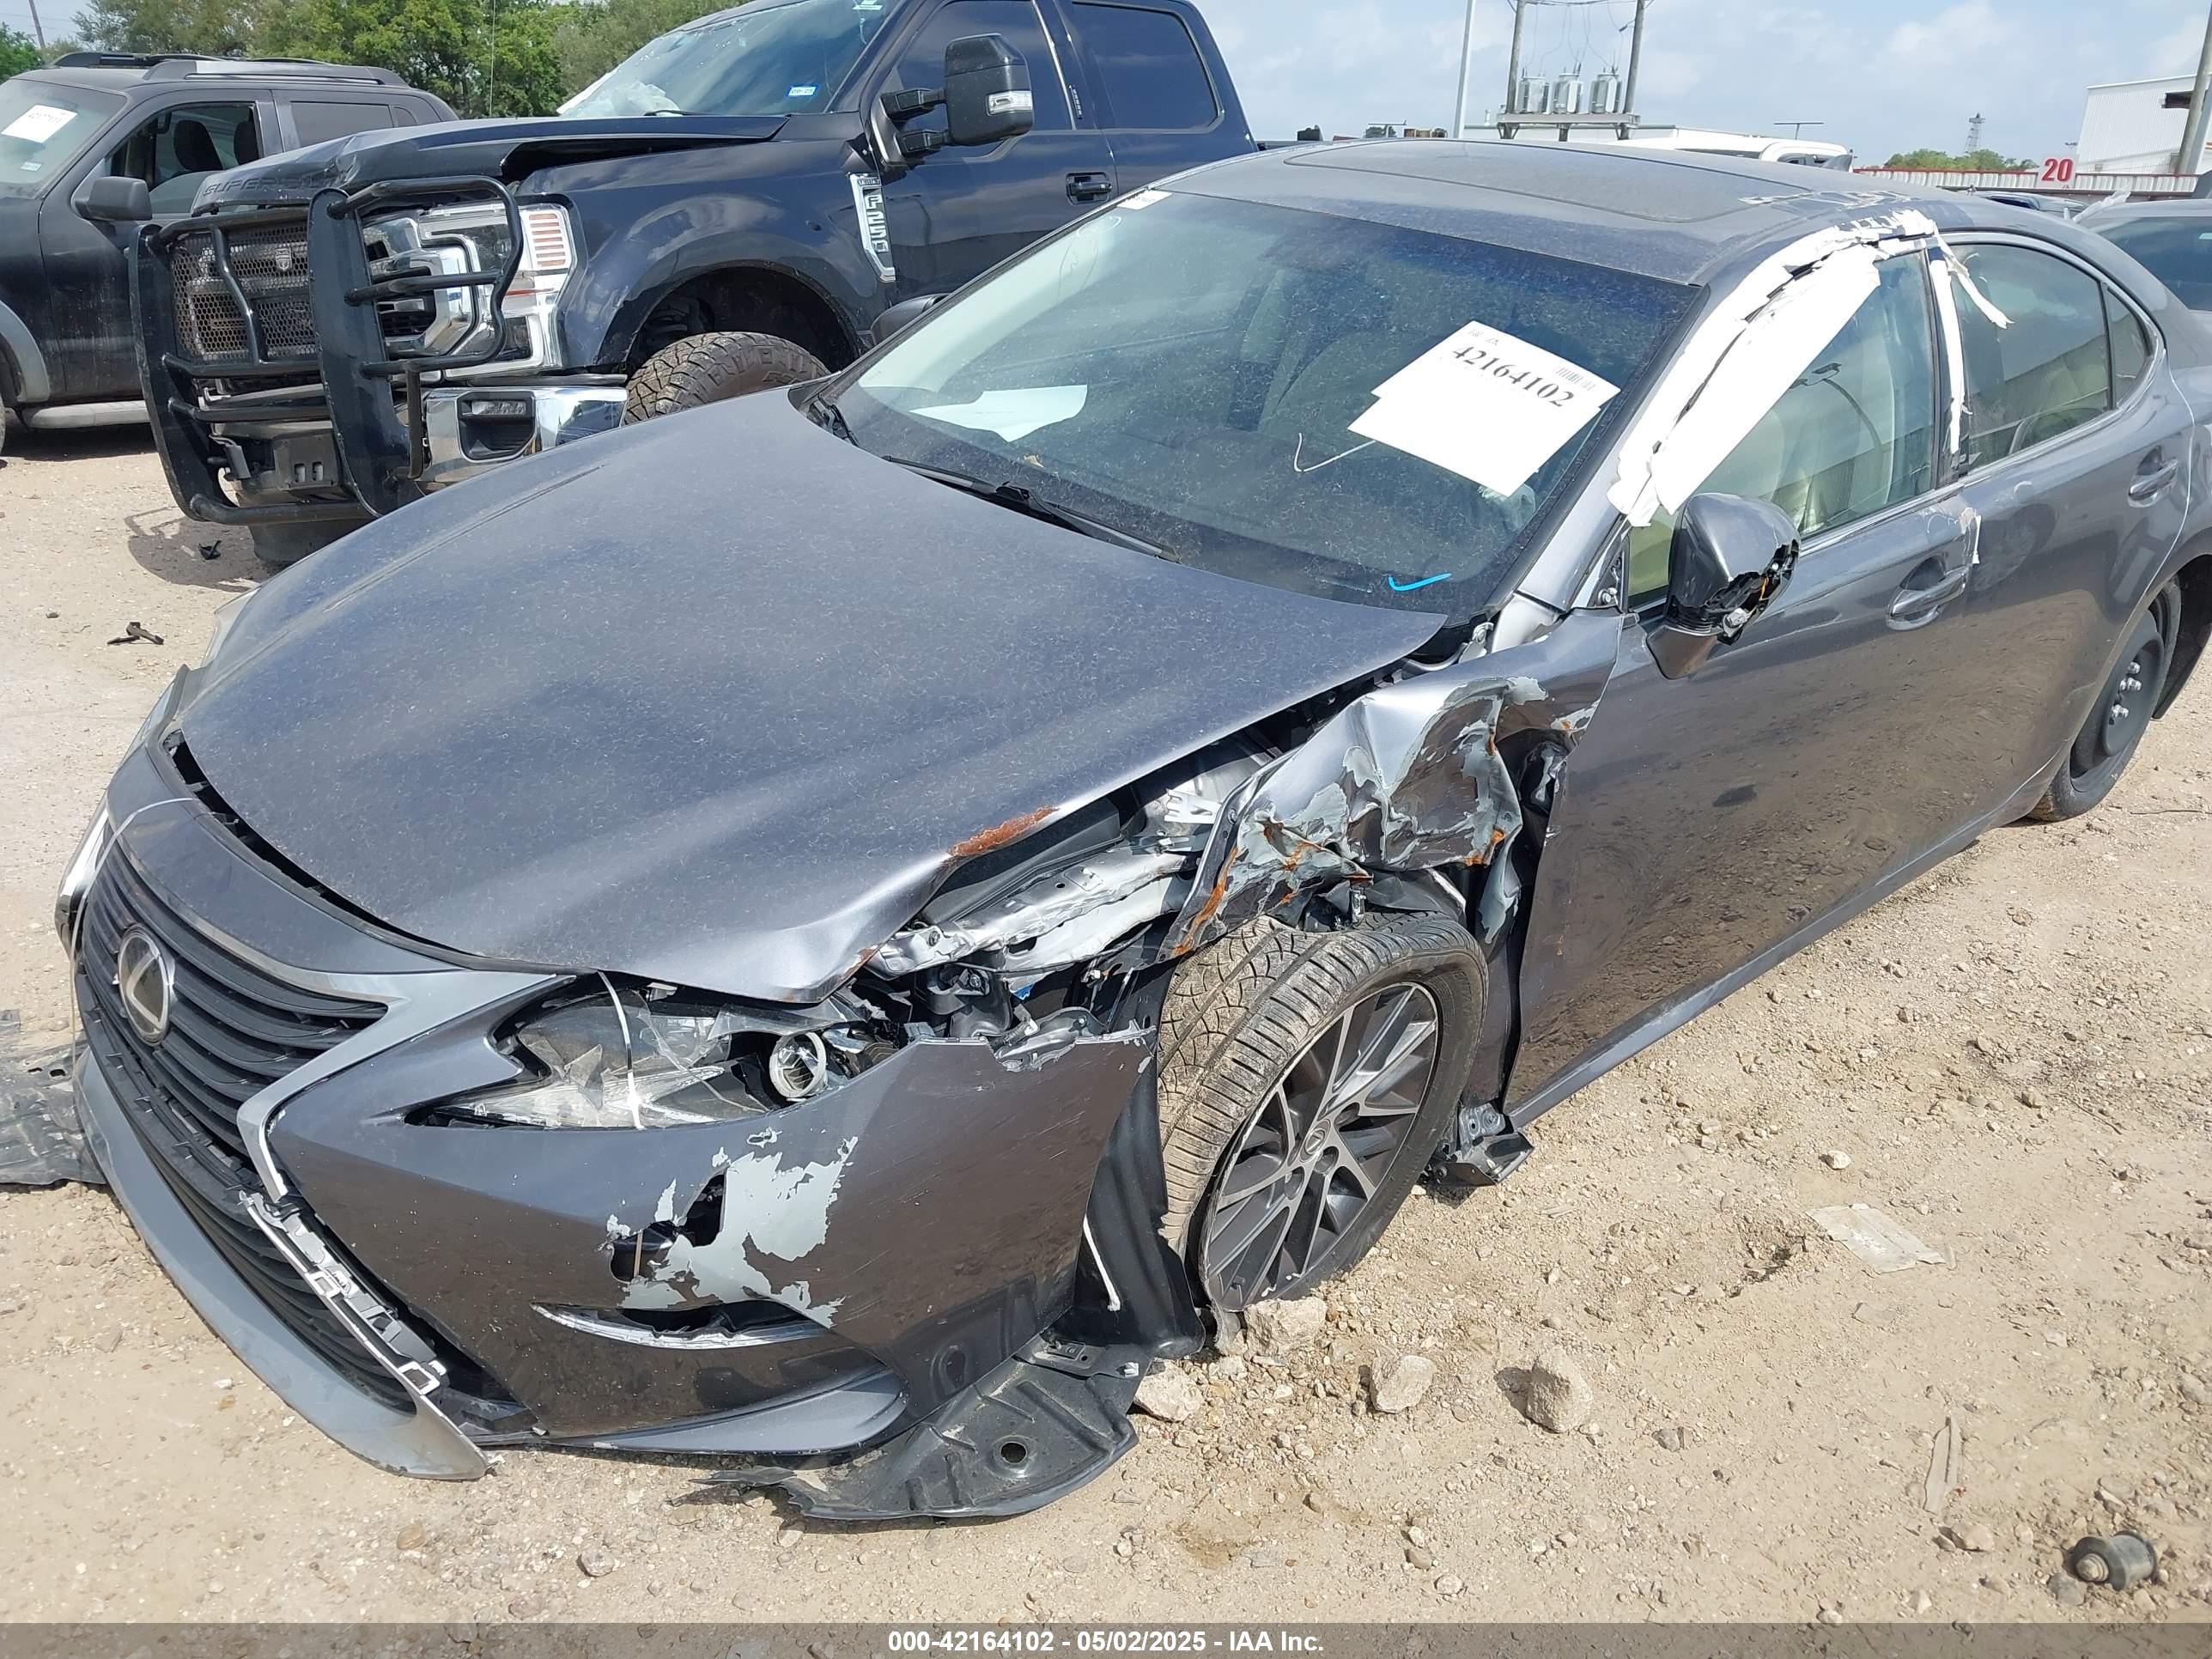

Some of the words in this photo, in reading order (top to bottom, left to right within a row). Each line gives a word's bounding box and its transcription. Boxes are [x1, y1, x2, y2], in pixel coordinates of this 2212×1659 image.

[204, 178, 278, 195] SUPER
[2042, 158, 2073, 182] 20
[864, 194, 889, 252] F250
[1453, 346, 1575, 406] 42164102
